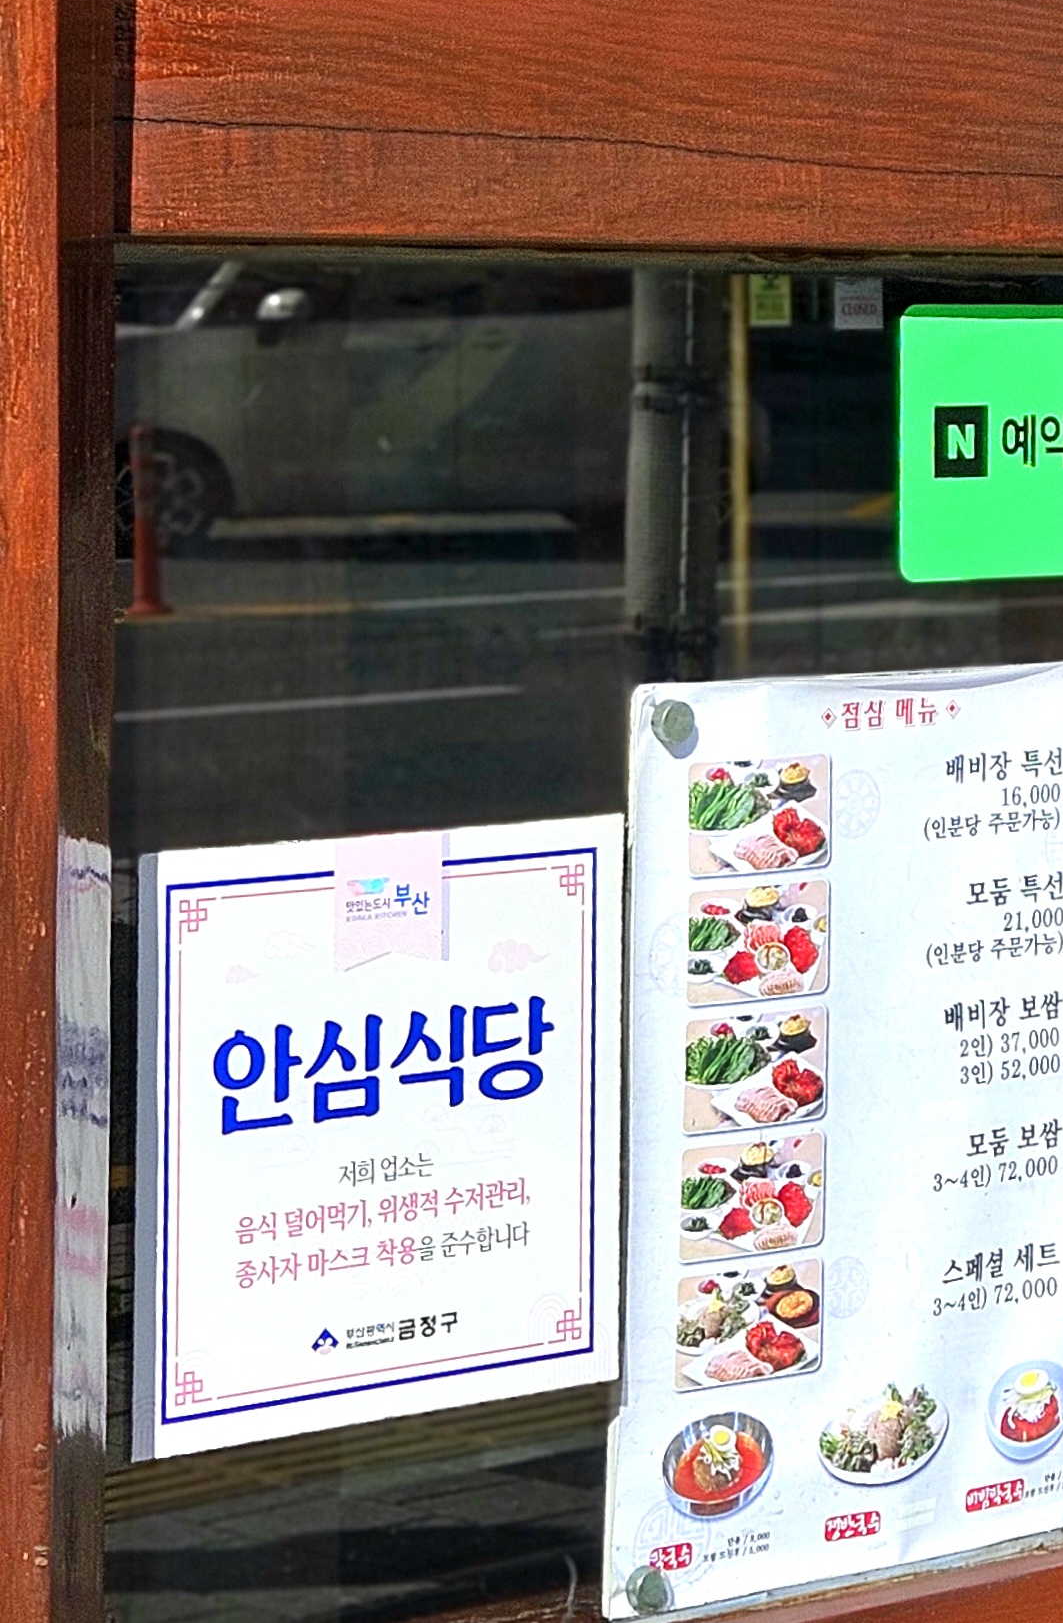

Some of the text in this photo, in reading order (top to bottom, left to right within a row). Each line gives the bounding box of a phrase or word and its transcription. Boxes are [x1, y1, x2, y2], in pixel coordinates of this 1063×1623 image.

[842, 697, 938, 729] 점심 메뉴
[945, 747, 1063, 783] 배비장 특선
[1002, 783, 1061, 807] 16,000
[924, 807, 1061, 841] (인분당 주문가능)
[394, 883, 430, 916] 부산
[966, 878, 1012, 906] 모둠
[926, 930, 1063, 968] (인분당 주문가능)
[944, 990, 1063, 1033] 배비장 보쌈
[960, 1027, 1060, 1058] 2인) 37,000
[213, 996, 555, 1136] 안심식당
[960, 1053, 1061, 1085] 3인) 52,000
[966, 1119, 1063, 1157] 모둠 보쌈
[338, 1153, 435, 1187] 저희 업소는
[933, 1155, 1058, 1192] 3~4인) 72,000
[235, 1177, 531, 1245] 음식 덜어먹기, 위생적 수저관리,
[235, 1221, 531, 1289] 종사자 마스크 착용을 준수합니다
[942, 1242, 1061, 1284] 스페셜 세트
[933, 1277, 1058, 1317] 3~4인) 72,000
[398, 1311, 458, 1341] 금정구
[967, 1481, 1023, 1510] 비빔막국수
